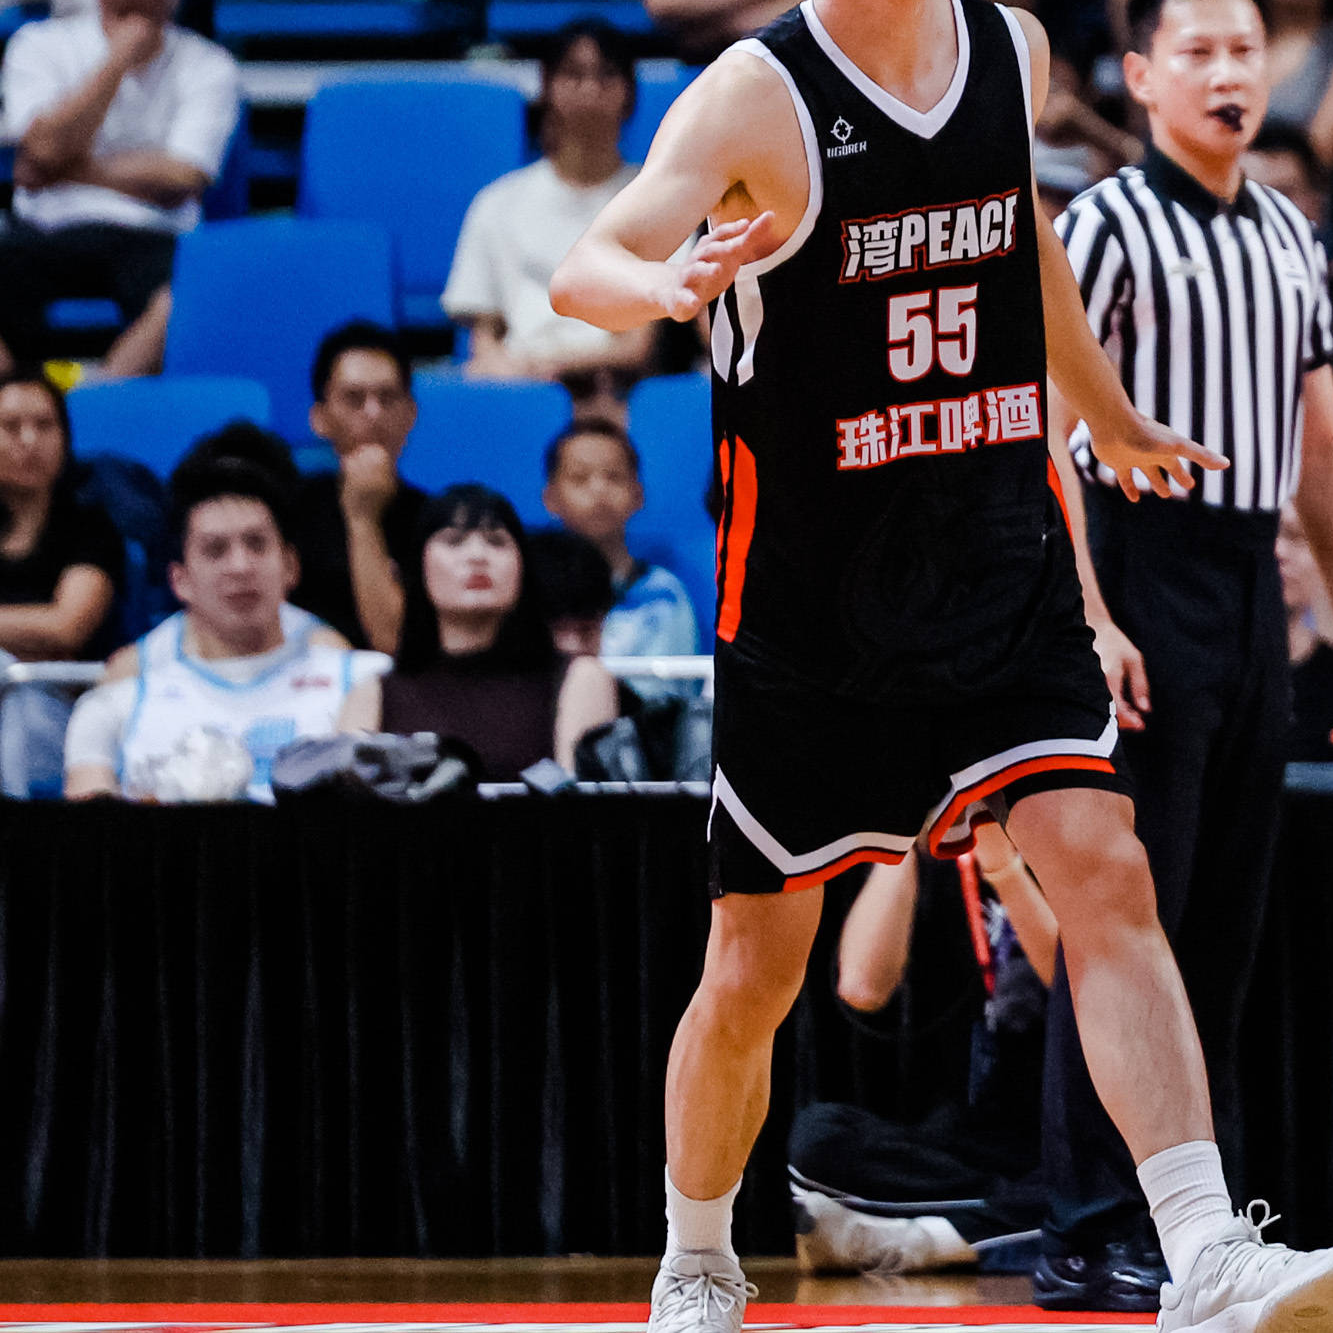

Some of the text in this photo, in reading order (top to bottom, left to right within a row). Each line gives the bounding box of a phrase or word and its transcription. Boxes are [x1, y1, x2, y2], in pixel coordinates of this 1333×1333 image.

[887, 283, 979, 383] 55
[838, 384, 1042, 469] 珠江啤酒
